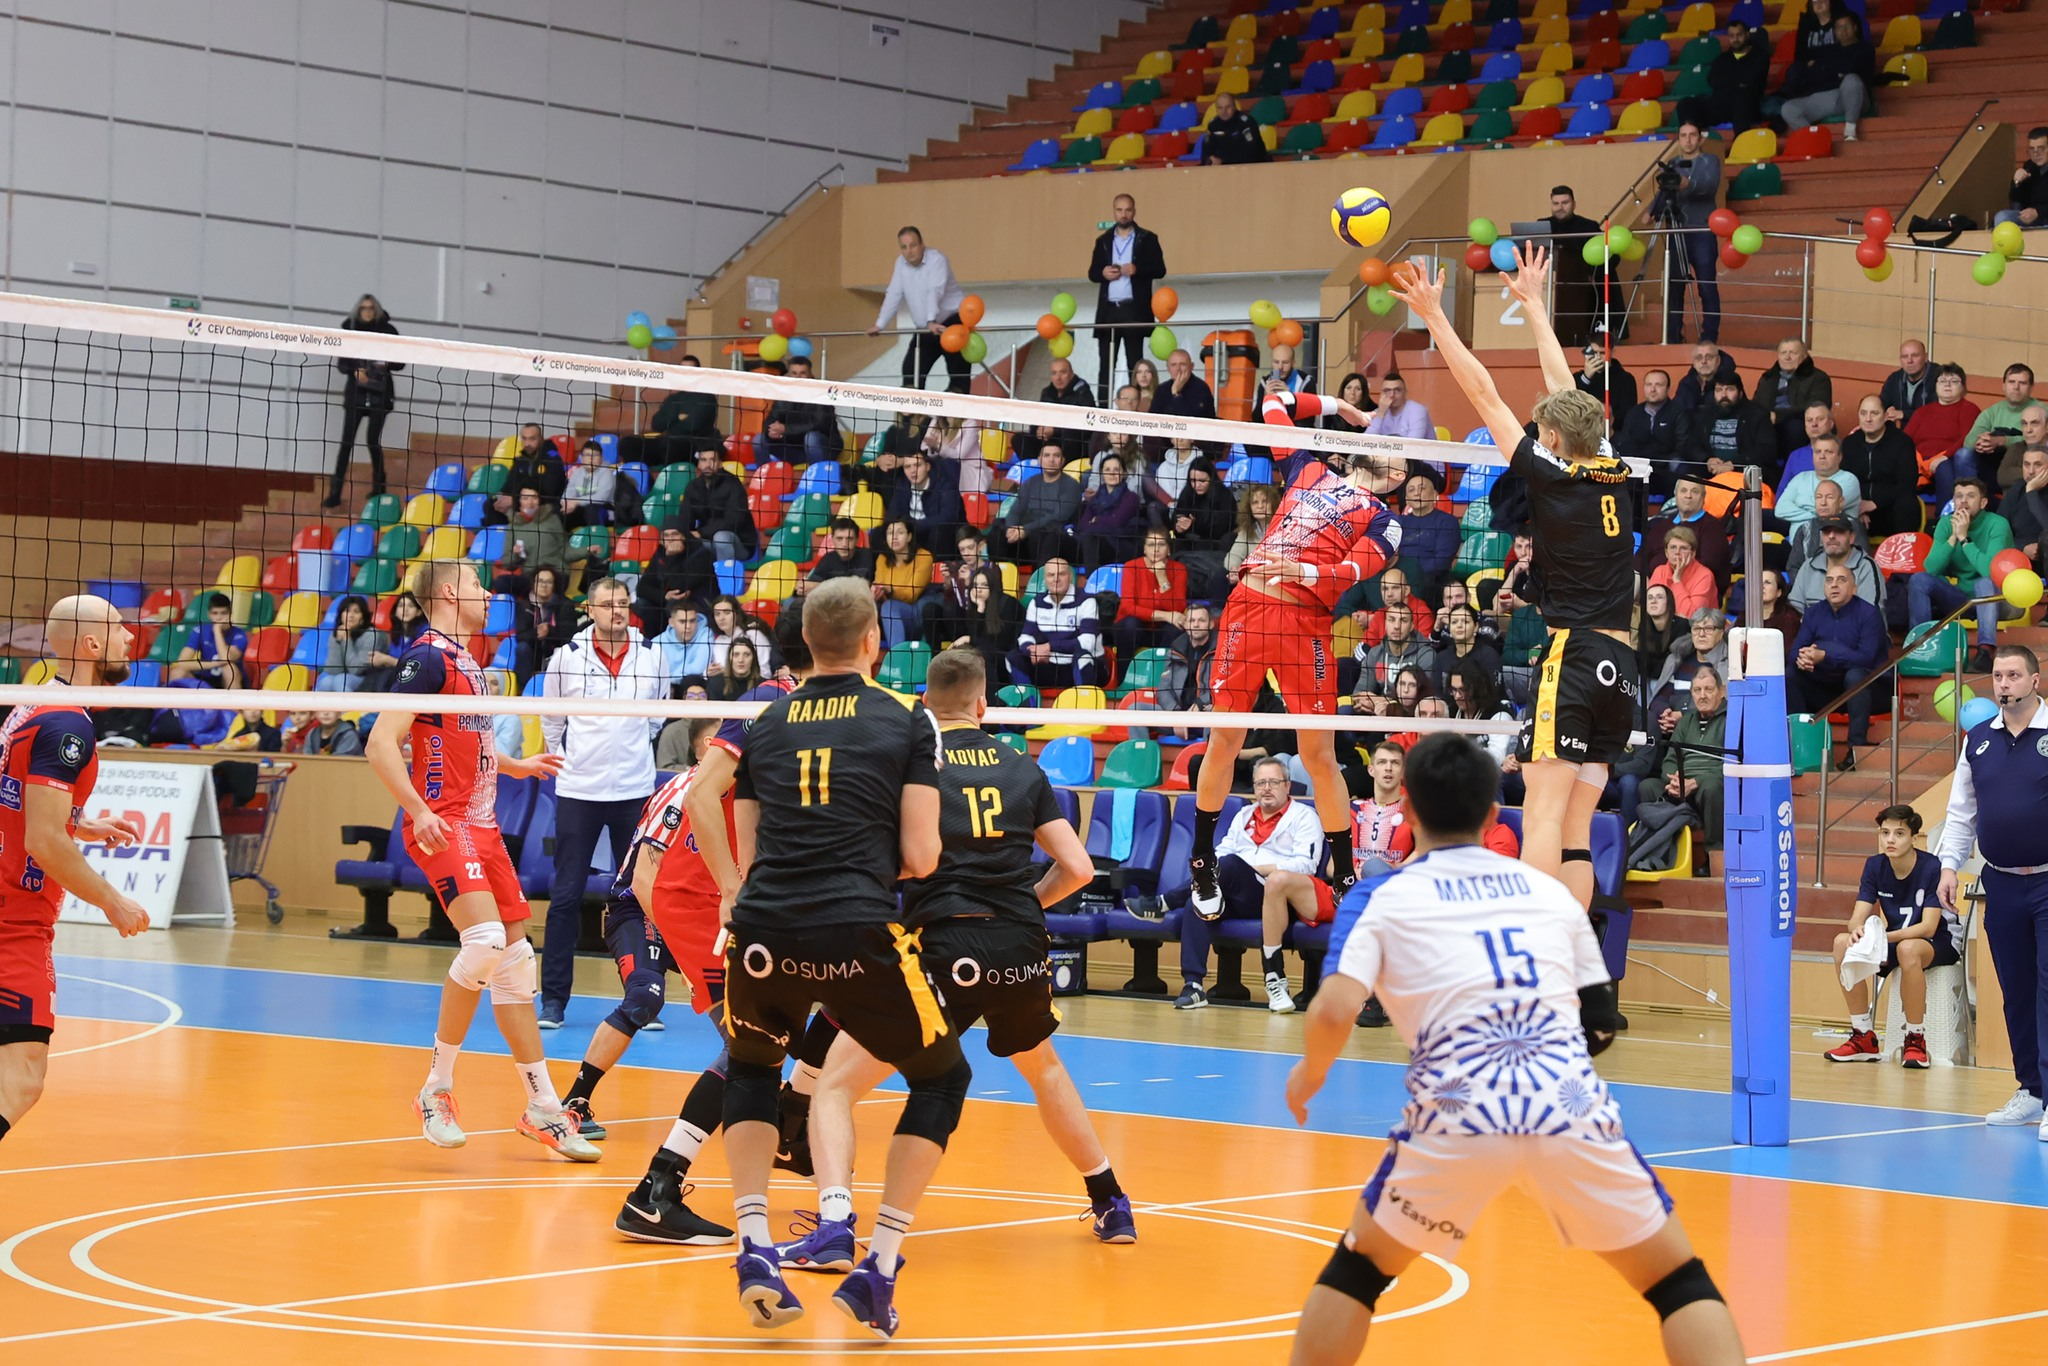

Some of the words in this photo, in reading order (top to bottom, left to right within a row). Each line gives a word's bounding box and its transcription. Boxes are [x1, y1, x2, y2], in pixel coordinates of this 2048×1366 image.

[1500, 286, 1525, 325] 2
[207, 323, 224, 335] CEV
[226, 326, 269, 339] Champions
[270, 330, 298, 343] League
[300, 333, 322, 347] Volley
[323, 336, 342, 347] 2023
[550, 360, 564, 369] CEV
[565, 361, 602, 374] Champions
[603, 365, 627, 376] League
[628, 367, 648, 379] Volley
[649, 370, 664, 379] 2023
[842, 390, 856, 398] CEV
[856, 391, 889, 402] Champions
[889, 394, 910, 405] League
[911, 396, 929, 407] Volley
[929, 398, 944, 407] 2023
[1099, 415, 1111, 424] CEV
[1111, 417, 1139, 427] Champions
[1140, 419, 1159, 429] League
[1160, 421, 1174, 431] Volley
[1175, 422, 1188, 431] 2023
[1601, 494, 1620, 538] 8
[1311, 638, 1327, 681] NAVROM
[1547, 664, 1554, 682] 8
[786, 695, 859, 723] RAADIK
[70, 736, 81, 745] CEV
[424, 735, 443, 801] amiro
[944, 747, 1000, 767] KOVAC
[796, 747, 832, 807] 11
[139, 787, 180, 799] PODURI
[670, 806, 681, 815] CEV
[962, 786, 1005, 838] 12
[1371, 822, 1379, 841] 5
[465, 862, 484, 879] 22
[1778, 829, 1792, 930] Senoh
[1434, 872, 1532, 902] MATSUO
[1899, 906, 1913, 930] 7
[648, 945, 661, 960] 17
[1474, 926, 1540, 990] 15
[781, 957, 865, 981] OSUMA
[526, 1070, 539, 1094] MIKASA
